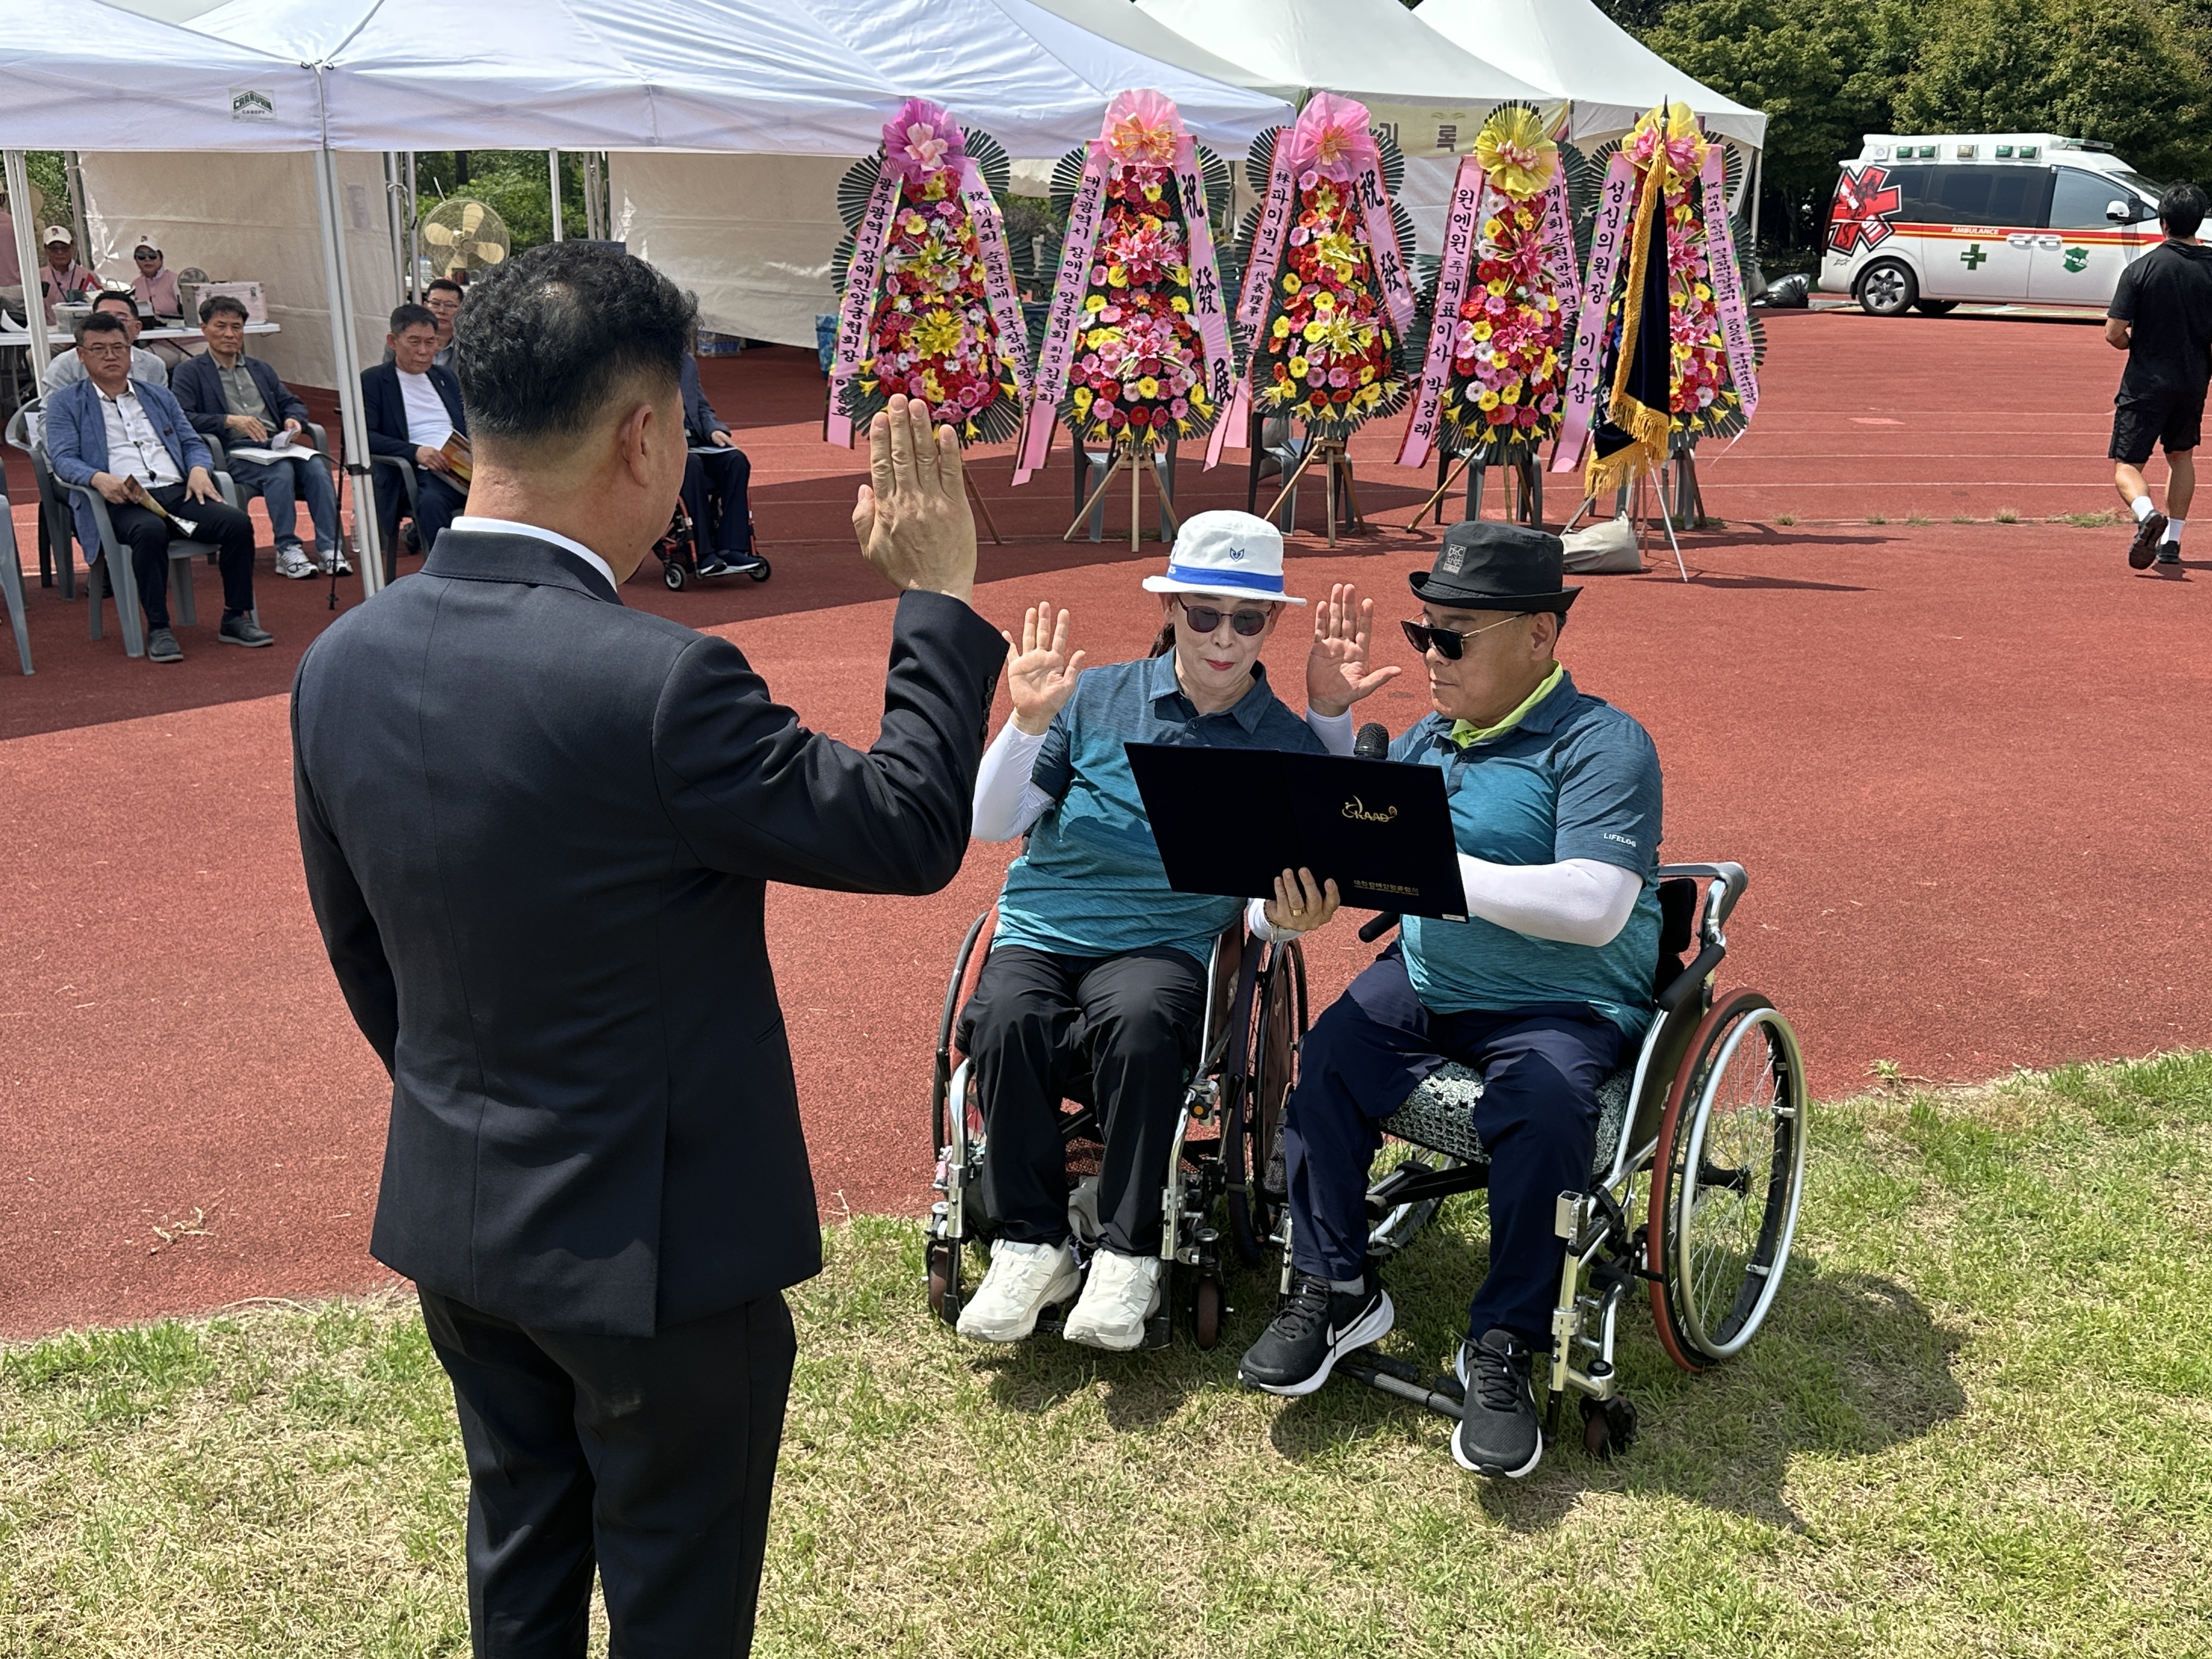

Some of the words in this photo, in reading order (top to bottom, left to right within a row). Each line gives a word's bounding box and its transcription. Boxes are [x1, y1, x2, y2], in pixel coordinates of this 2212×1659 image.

[233, 93, 272, 110] CARAVAN
[1070, 176, 1101, 240] 대전광역시
[1063, 246, 1087, 285] 장애인
[1588, 180, 1625, 304] 성심의원장
[1569, 332, 1595, 404] 이우삼
[1414, 376, 1445, 440] 박경래
[1603, 832, 1637, 848] LIFELOG
